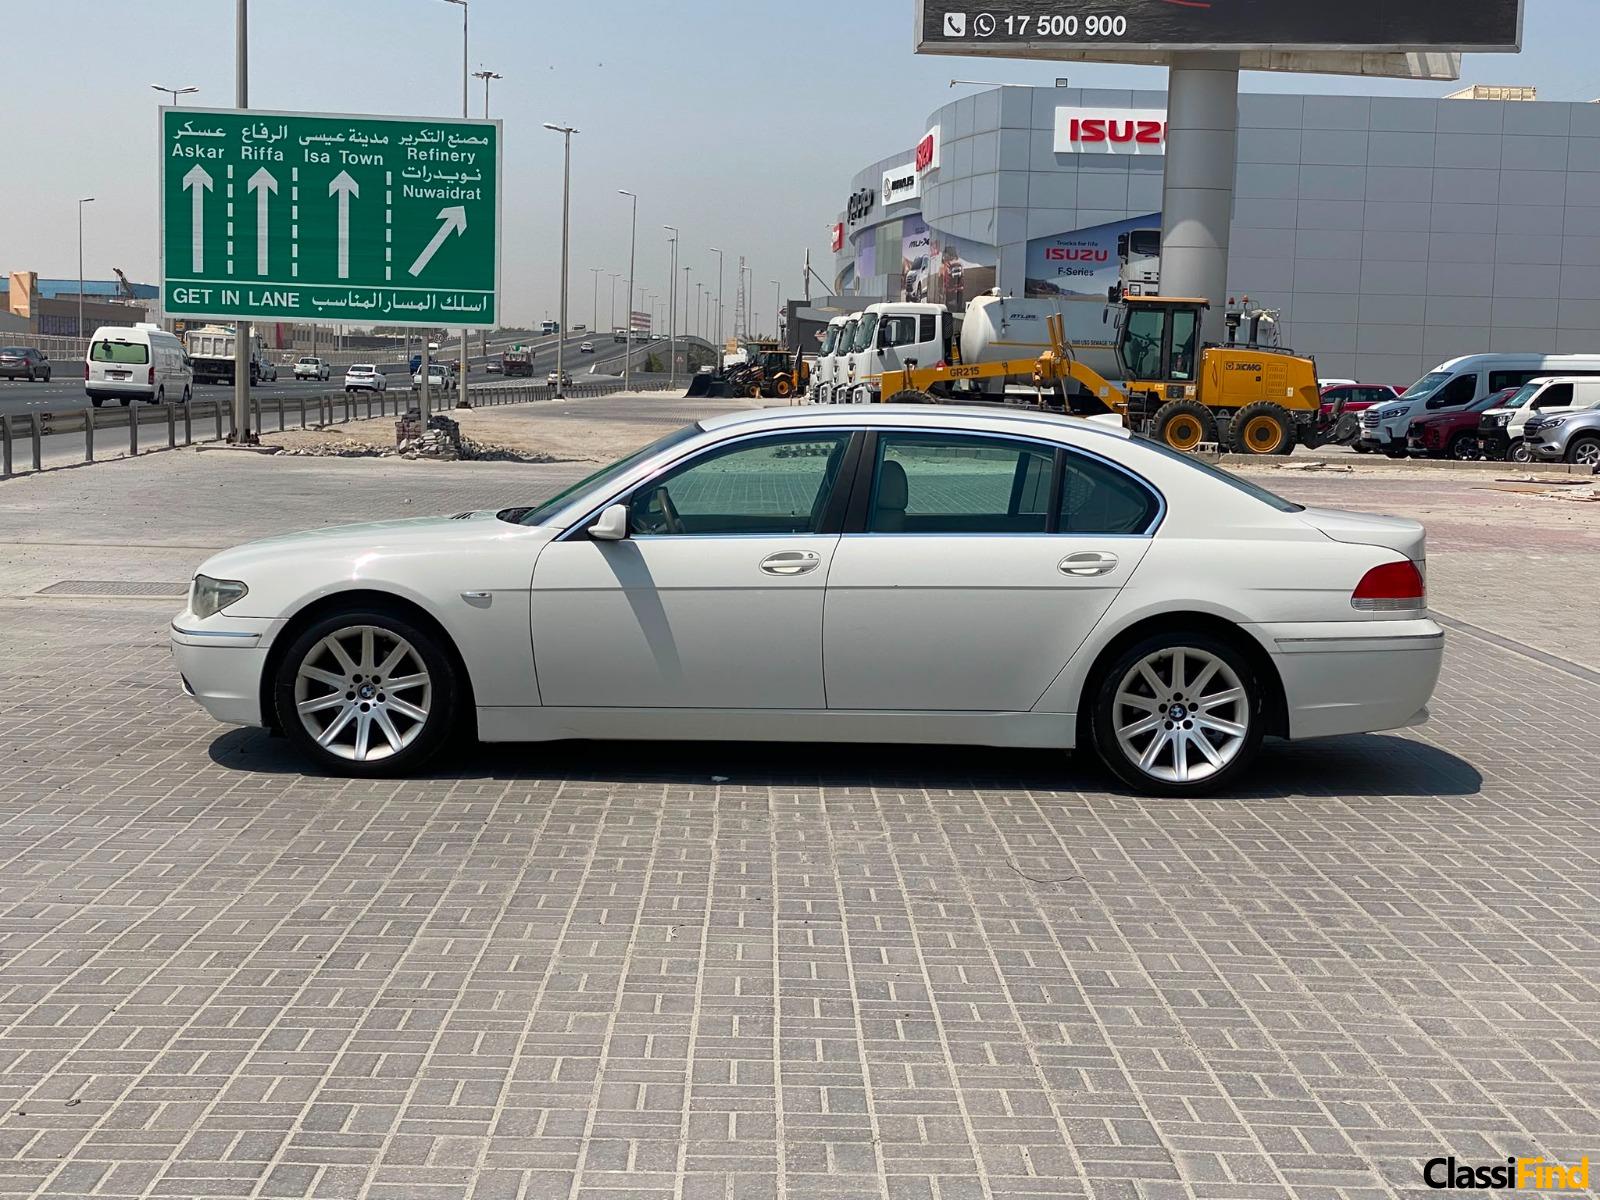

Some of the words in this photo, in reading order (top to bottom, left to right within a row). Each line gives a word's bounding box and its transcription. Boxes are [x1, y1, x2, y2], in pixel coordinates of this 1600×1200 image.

[1004, 15, 1030, 35] 17
[1037, 15, 1078, 36] 500
[1085, 15, 1126, 36] 900
[172, 120, 226, 139] عسكر
[241, 122, 287, 143] الرفاع
[348, 128, 389, 147] مدينة
[398, 129, 444, 146] التكرير
[1070, 119, 1168, 143] ISUZ
[298, 133, 345, 146] عيسى
[447, 133, 488, 148] مصنع
[172, 143, 225, 158] Askar
[241, 145, 284, 161] Riffa
[304, 149, 330, 163] Isa
[339, 150, 384, 165] Town
[407, 147, 475, 164] Refinery
[402, 165, 482, 184] نويدرات
[403, 184, 481, 200] Nuwaidrat
[1045, 248, 1108, 262] ISUZU
[1057, 266, 1094, 276] F-Series
[173, 287, 213, 305] GET
[221, 289, 240, 306] IN
[249, 290, 300, 308] LANE
[312, 291, 382, 312] المناسب
[383, 292, 436, 313] المسار
[440, 294, 487, 312] اسلك
[950, 366, 980, 377] GR215
